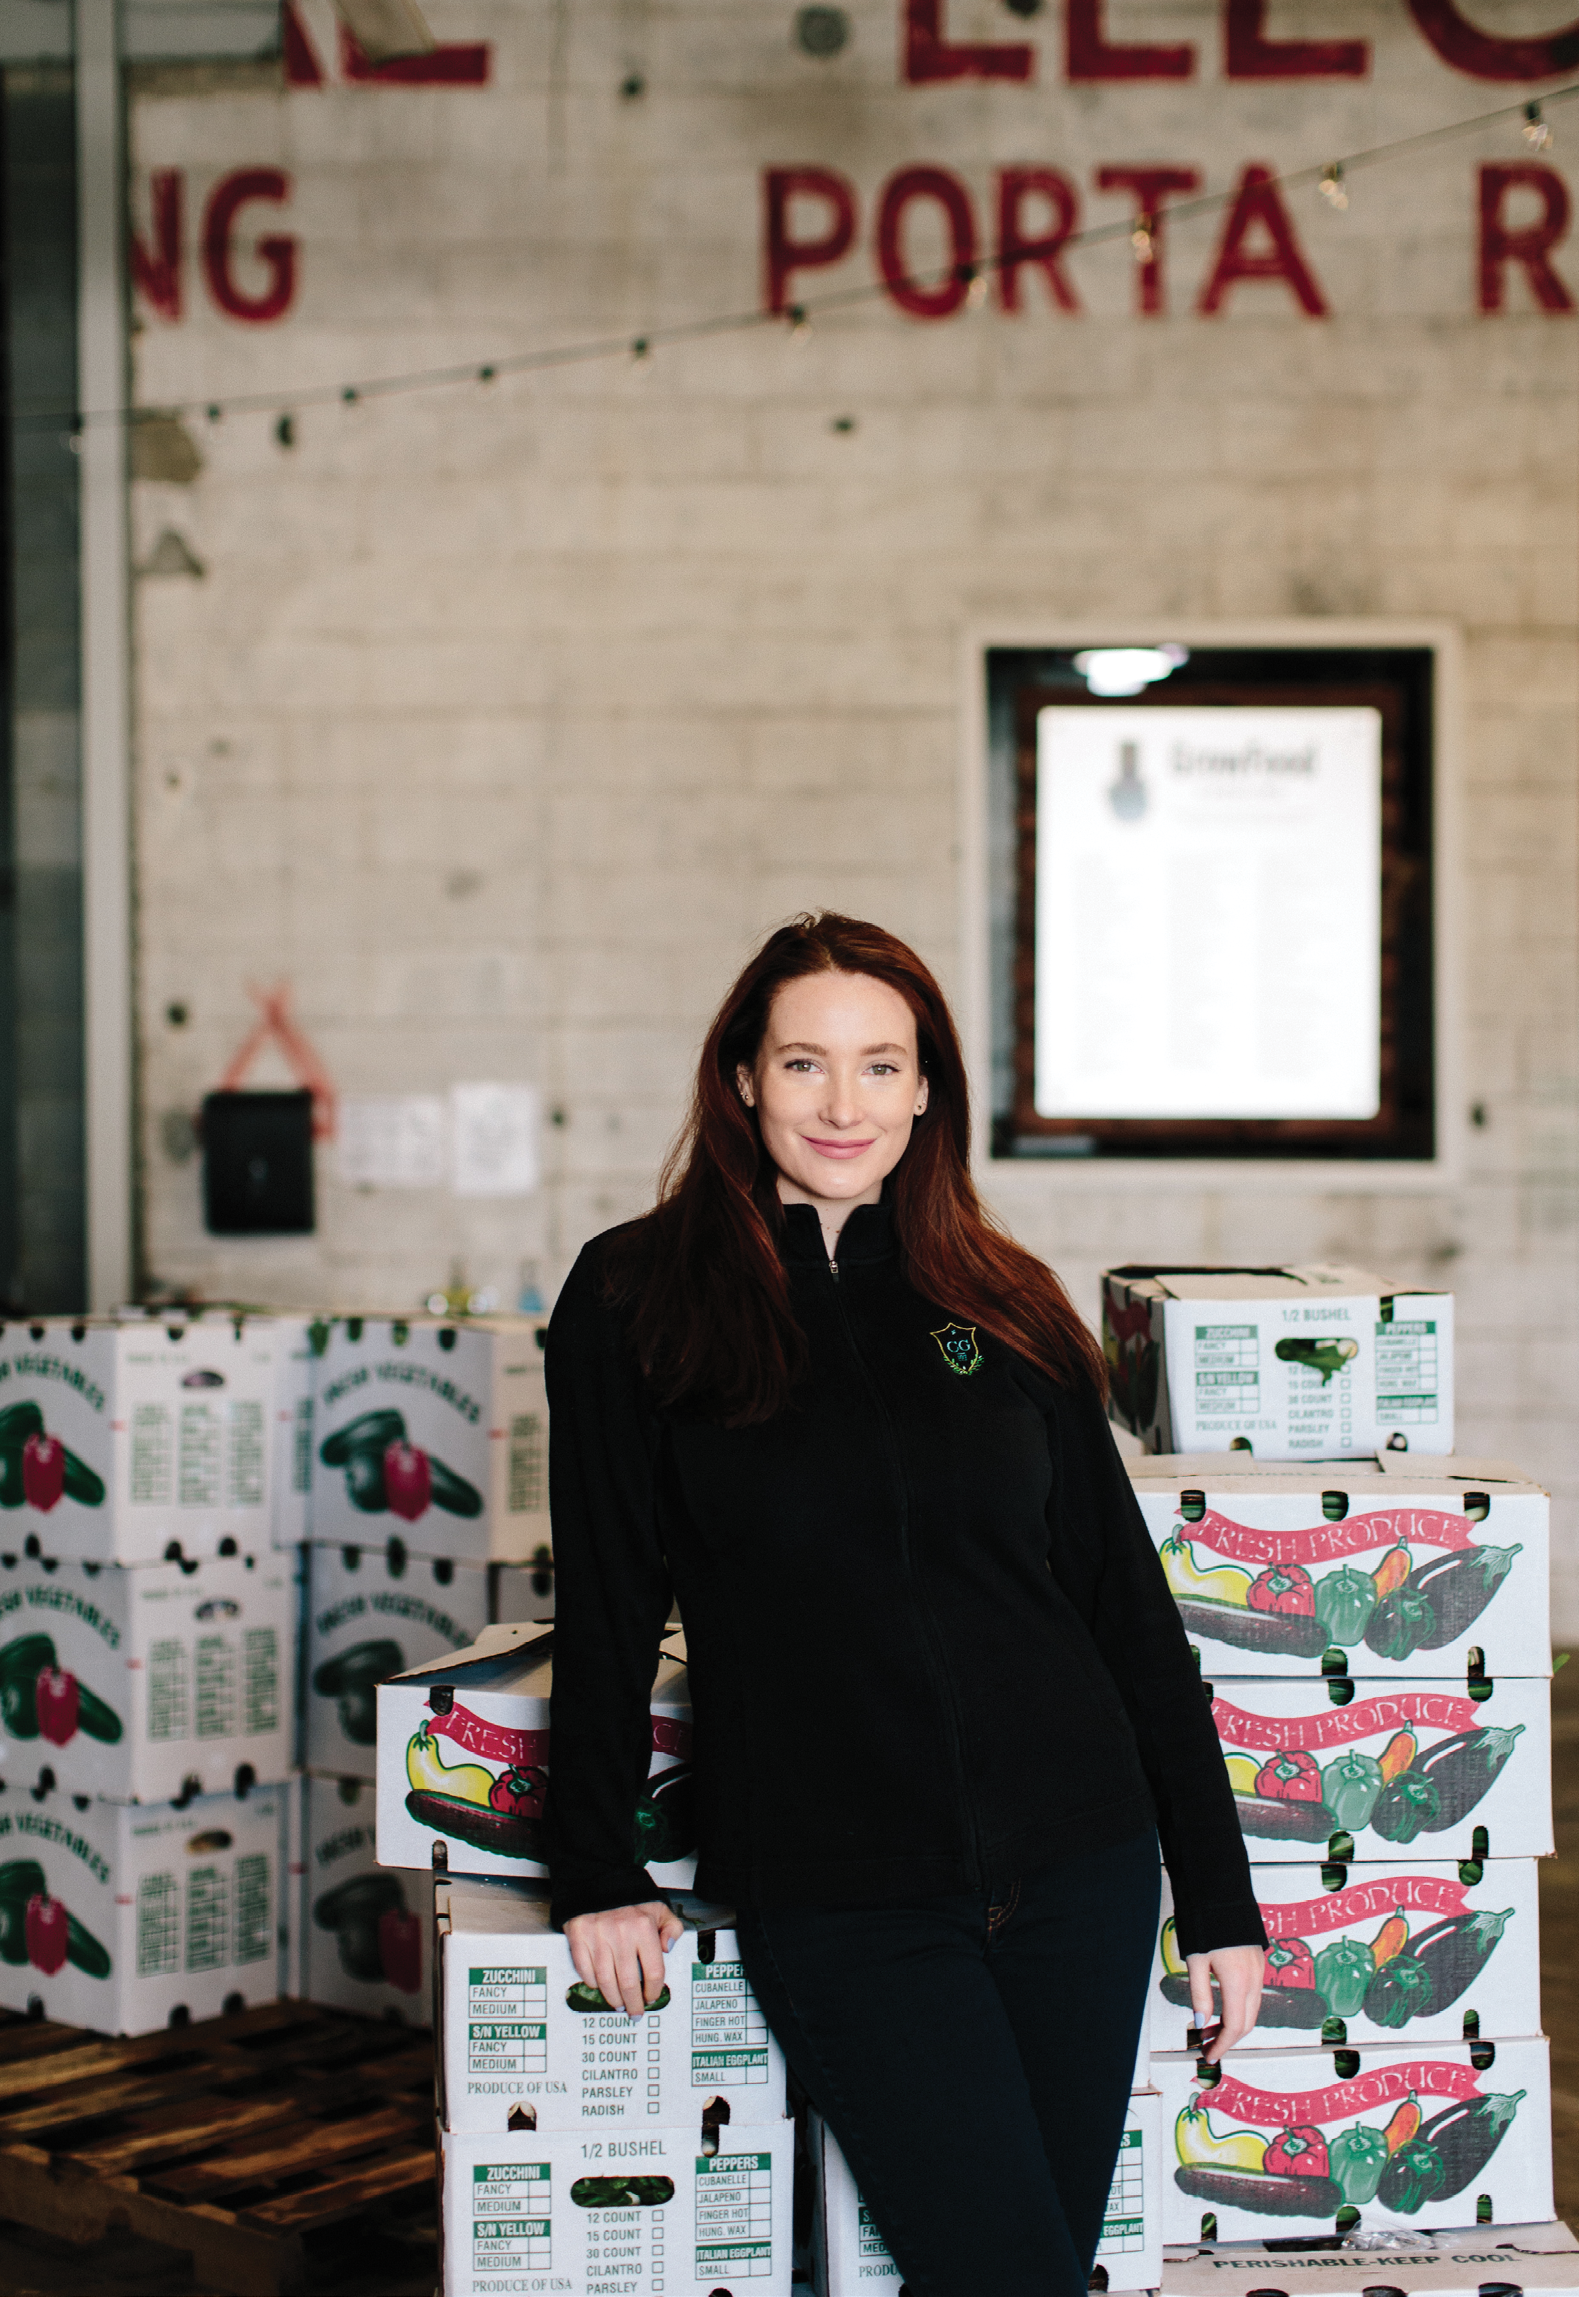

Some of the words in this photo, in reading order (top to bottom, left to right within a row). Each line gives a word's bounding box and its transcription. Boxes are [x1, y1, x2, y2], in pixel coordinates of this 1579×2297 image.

[761, 162, 1327, 320] PORTA
[1476, 163, 1574, 314] R
[1282, 1310, 1299, 1322] 1/2
[1303, 1308, 1350, 1321] BUSHEL
[946, 1339, 971, 1352] CG
[1197, 1515, 1297, 1561] FRESH
[1308, 1512, 1460, 1558] PRODUCE
[1316, 1696, 1463, 1743] PRODUCE
[445, 1710, 537, 1760] FRESH
[1308, 1880, 1455, 1929] PRODUCE
[482, 1970, 536, 1984] ZUCCHINI
[472, 1986, 508, 1998] FANCY
[695, 1982, 744, 1992] CUBANELLE
[472, 2004, 517, 2014] MEDIUM
[695, 1999, 738, 2010] JALAPENO
[582, 2018, 595, 2028] 12
[696, 2016, 726, 2026] FINGER
[728, 2016, 745, 2026] HOT
[472, 2026, 492, 2039] S/N
[494, 2026, 541, 2038] YELLOW
[696, 2032, 722, 2042] HUNG.
[724, 2032, 744, 2042] WAX
[582, 2034, 595, 2045] 15
[599, 2033, 638, 2044] COUNT
[472, 2042, 508, 2052] FANCY
[582, 2052, 595, 2062] 30
[599, 2050, 638, 2062] COUNT
[692, 2056, 724, 2068] ITALIAN
[726, 2054, 768, 2066] EGGPLANT
[472, 2058, 517, 2070] MEDIUM
[582, 2068, 638, 2080] CILANTRO
[695, 2072, 726, 2082] SMALL
[468, 2082, 524, 2094] PRODUCE
[527, 2082, 542, 2094] OF
[546, 2081, 568, 2093] USA
[582, 2086, 633, 2098] PARSLEY
[1213, 2082, 1312, 2122] FRESH
[1322, 2065, 1467, 2116] PRODUCE
[582, 2104, 624, 2116] RADISH
[582, 2144, 603, 2159] 1/2
[608, 2140, 667, 2158] BUSHEL
[709, 2156, 759, 2172] PEPPERS
[487, 2166, 541, 2181] ZUCCHINI
[699, 2174, 746, 2186] CUBANELLE
[477, 2184, 512, 2195] FANCY
[698, 2192, 741, 2204] JALAPENO
[477, 2201, 521, 2212] MEDIUM
[1108, 2202, 1120, 2212] AX
[587, 2213, 600, 2224] 12
[603, 2210, 642, 2222] COUNT
[700, 2209, 730, 2220] FINGER
[732, 2208, 748, 2218] HOT
[477, 2224, 496, 2238] S/N
[499, 2222, 545, 2236] YELLOW
[587, 2230, 600, 2242] 15
[603, 2228, 642, 2240] COUNT
[700, 2226, 726, 2237] HUNG.
[728, 2225, 746, 2236] WAX
[1104, 2224, 1144, 2237] EGGPLANT
[477, 2240, 512, 2250] FANCY
[586, 2248, 600, 2258] 30
[603, 2246, 642, 2258] COUNT
[697, 2249, 728, 2260] ITALIAN
[730, 2247, 772, 2259] EGGPLANT
[477, 2256, 522, 2268] MEDIUM
[1212, 2255, 1441, 2269] PERISHABLE-KEEP
[1450, 2253, 1523, 2264] COOL
[586, 2264, 642, 2276] CILANTRO
[700, 2264, 730, 2276] SMALL
[858, 2264, 898, 2278] PRODU
[472, 2280, 528, 2292] PRODUCE
[532, 2279, 547, 2291] OF
[550, 2278, 573, 2290] USA
[586, 2282, 638, 2295] PARSLEY
